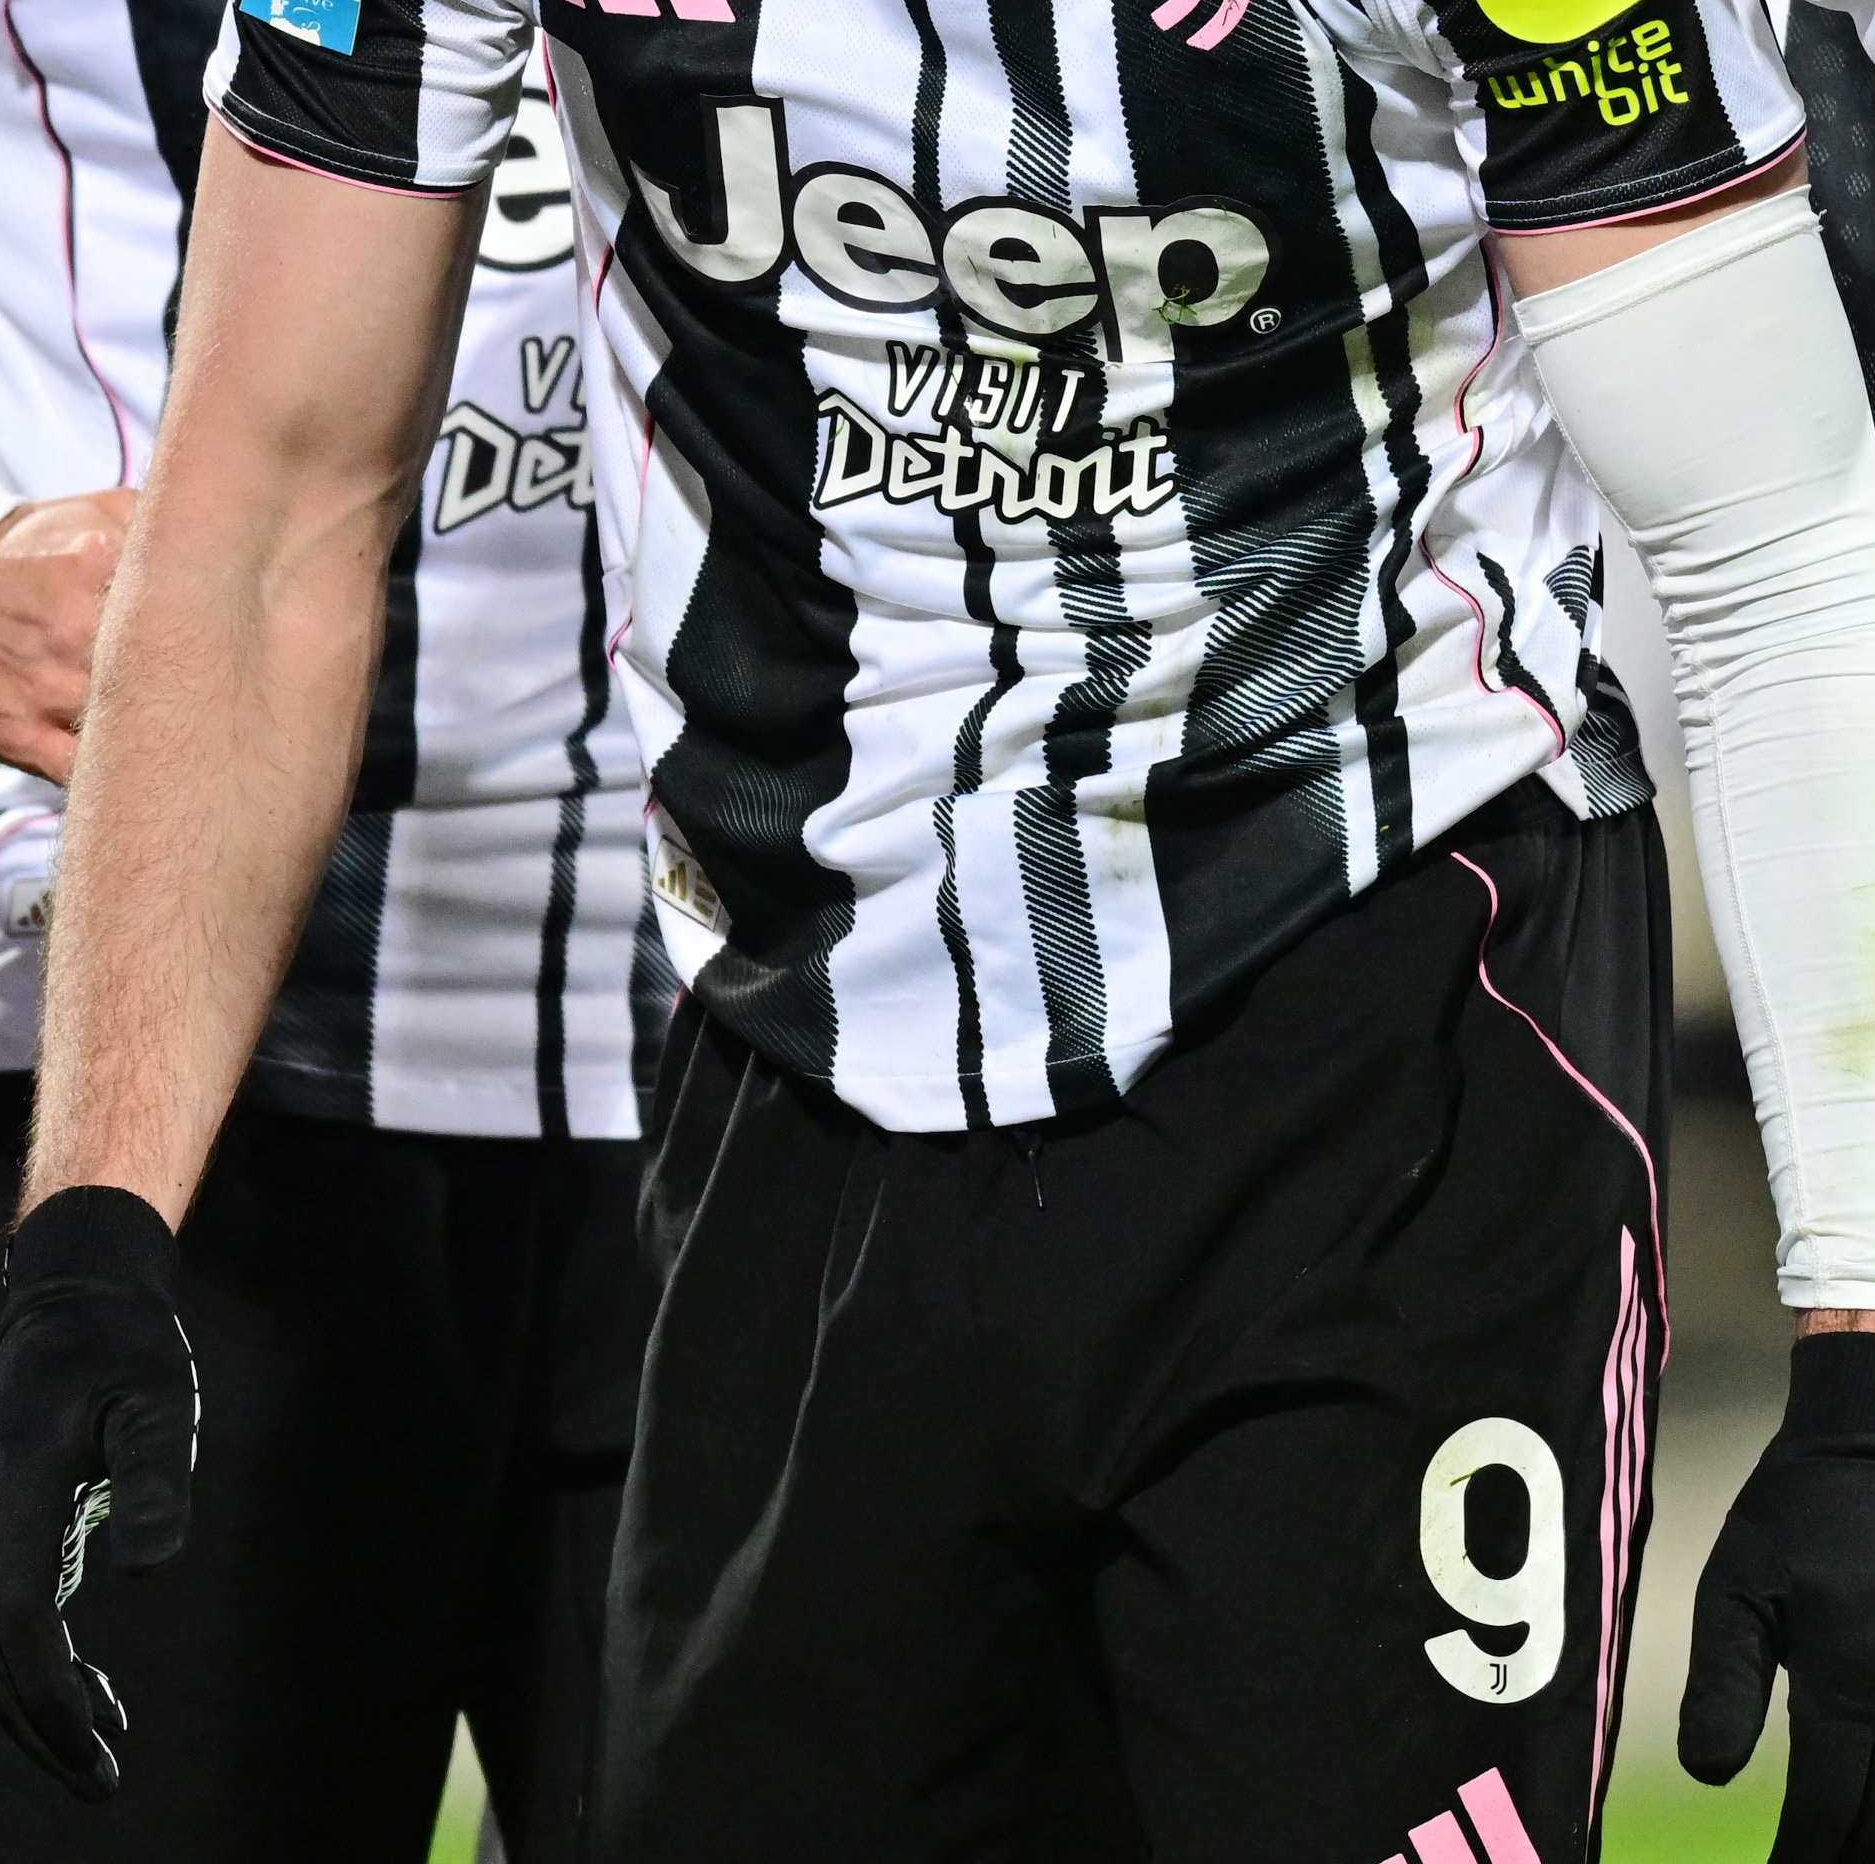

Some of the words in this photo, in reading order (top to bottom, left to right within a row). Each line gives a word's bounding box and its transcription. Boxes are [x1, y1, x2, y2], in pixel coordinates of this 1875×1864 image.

[631, 104, 1270, 364] Jeep
[817, 392, 1174, 520] Detroit
[890, 342, 1085, 433] VISIT
[1420, 1417, 1565, 1704] 9
